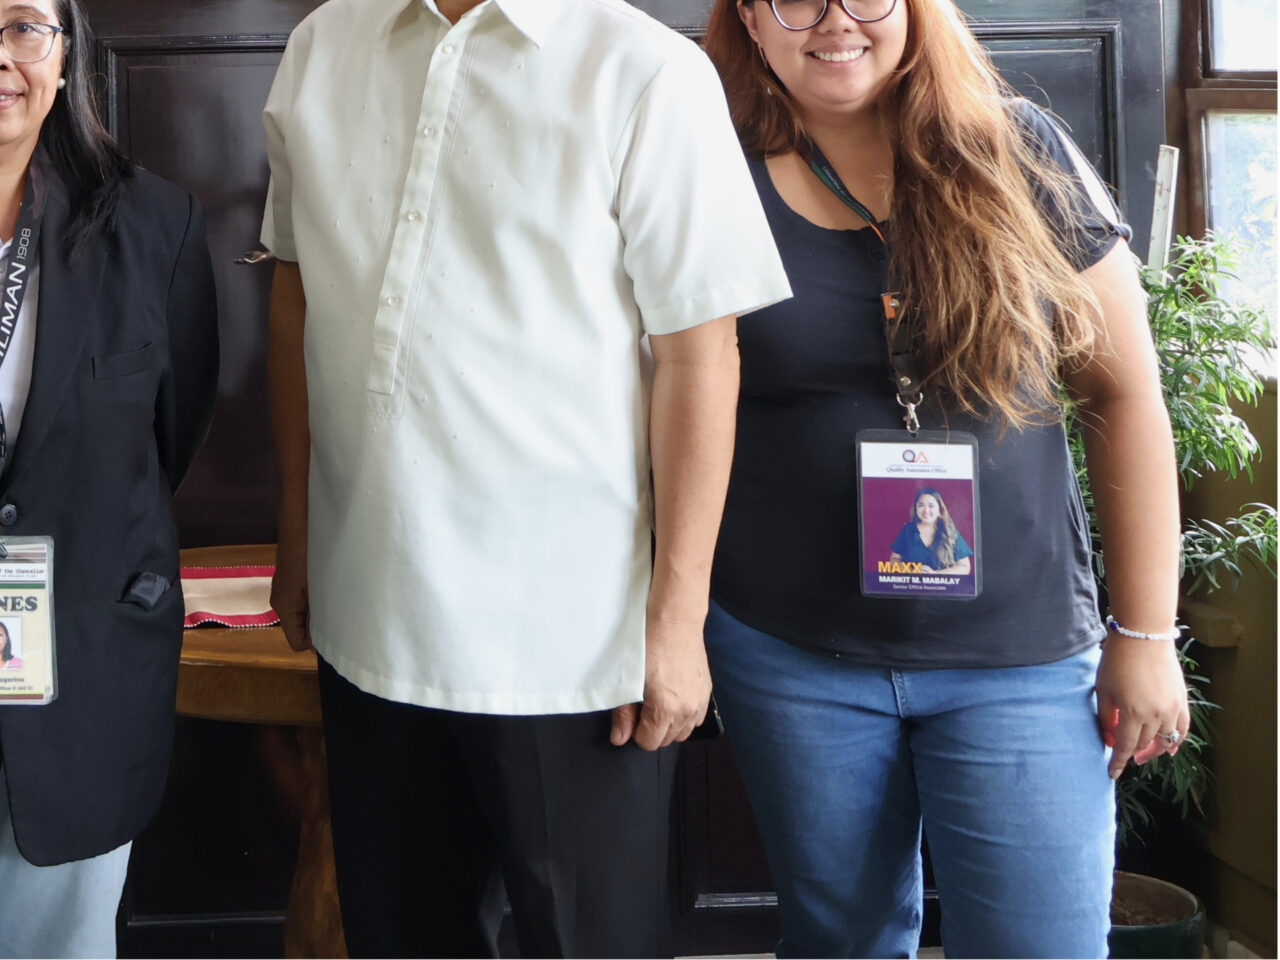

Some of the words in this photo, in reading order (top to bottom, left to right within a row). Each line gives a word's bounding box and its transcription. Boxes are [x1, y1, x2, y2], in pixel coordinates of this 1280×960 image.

[16, 228, 32, 260] 1908
[877, 561, 922, 574] MAXX
[878, 575, 911, 583] MARIKIT
[911, 576, 922, 584] M.
[922, 576, 960, 585] MABALAY
